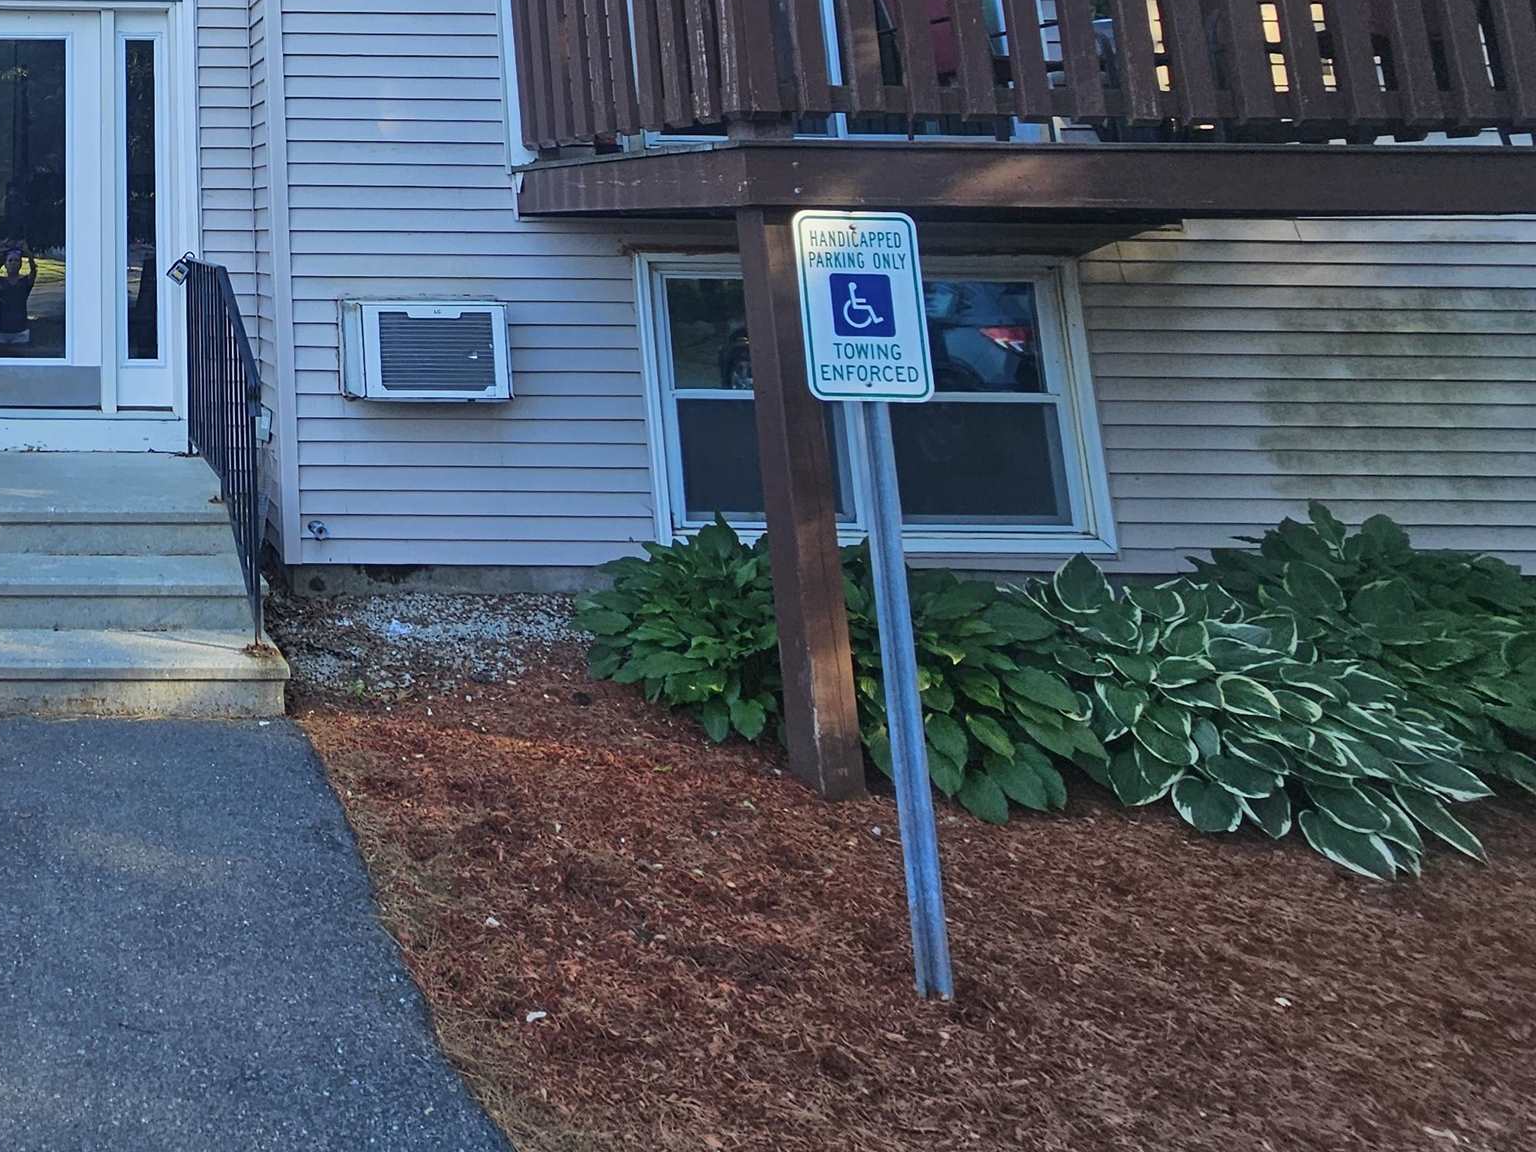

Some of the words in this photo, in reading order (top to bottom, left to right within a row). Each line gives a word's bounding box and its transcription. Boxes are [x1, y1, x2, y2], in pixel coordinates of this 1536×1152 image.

[809, 230, 902, 249] HANDICAPPED
[808, 252, 865, 269] PARKING
[872, 252, 906, 270] ONLY
[832, 342, 902, 361] TOWING
[819, 364, 919, 383] ENFORCED
